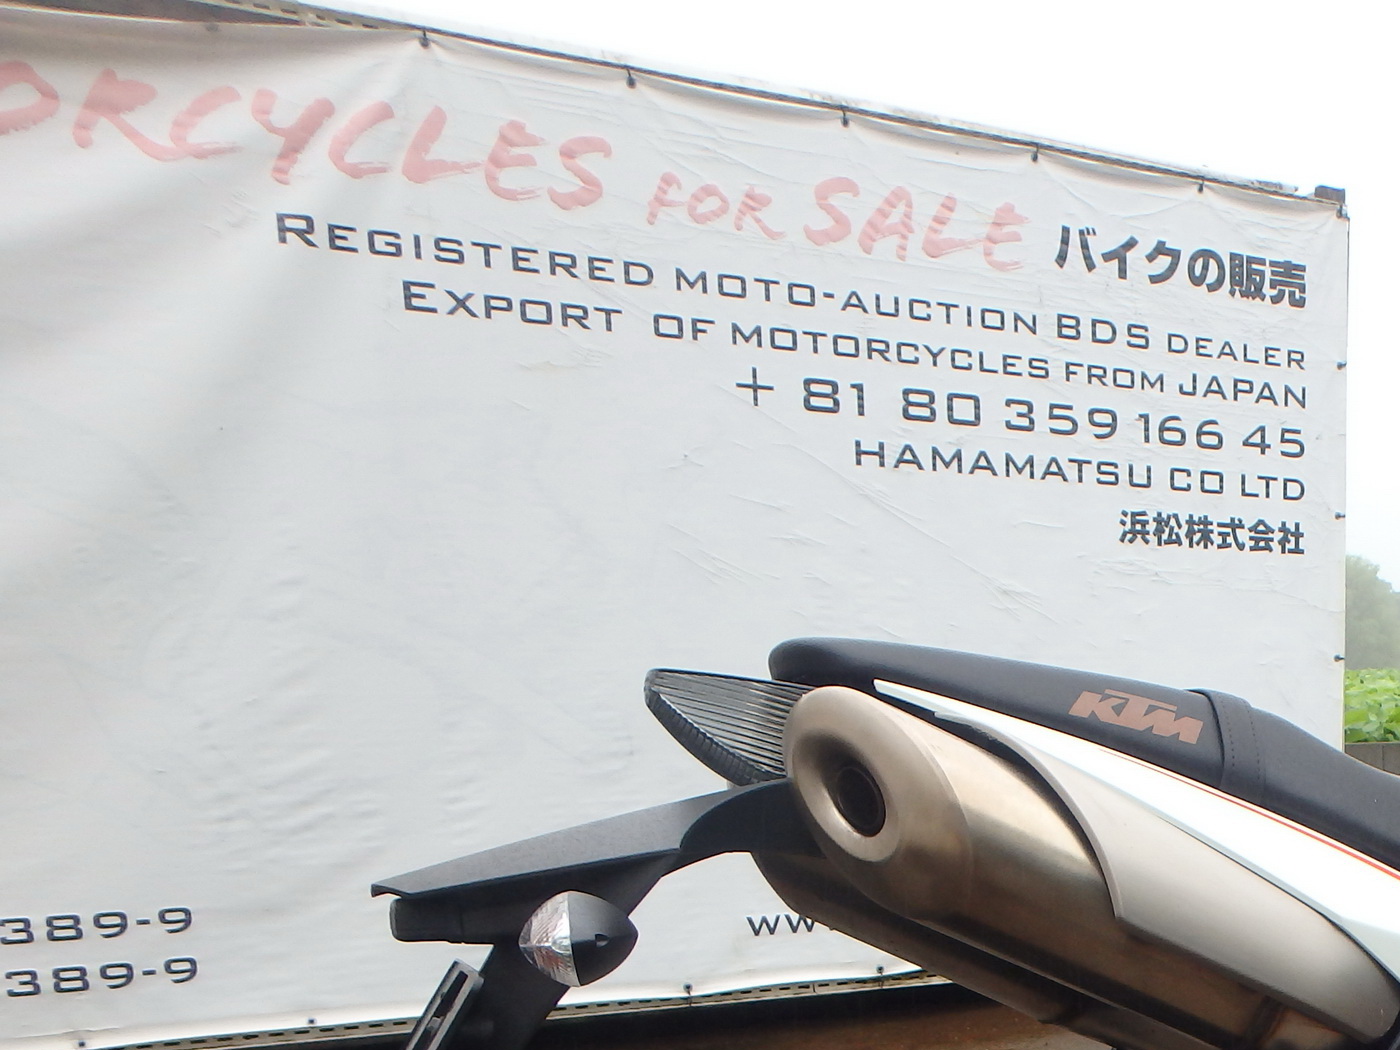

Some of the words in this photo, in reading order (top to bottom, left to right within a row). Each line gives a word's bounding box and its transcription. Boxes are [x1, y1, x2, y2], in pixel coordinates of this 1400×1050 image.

[646, 170, 782, 239] FOR
[803, 175, 1030, 272] SALE
[276, 212, 654, 288] REGISTERED
[675, 267, 1037, 337] MOTO-AUCTION
[1056, 313, 1150, 350] BDS
[1167, 332, 1306, 371] DEALER
[1054, 224, 1307, 309] バイクの販売
[402, 279, 623, 333] EXPORT
[652, 313, 716, 342] OF
[731, 322, 1050, 380] MOTORCYCLES
[1064, 361, 1165, 393] FROM
[1178, 372, 1307, 410] JAPAN
[735, 366, 775, 407] +
[802, 377, 866, 417] 81
[901, 387, 982, 427] 80
[1004, 398, 1118, 440] 359
[1134, 412, 1224, 451] 166
[1241, 425, 1306, 459] 45
[854, 439, 1152, 489] HAMAMATSU
[1169, 467, 1225, 495] CO
[1240, 473, 1306, 502] LTD
[1118, 510, 1305, 555] 浜松株式会社
[1068, 688, 1204, 745] KTM
[0, 906, 193, 945] 389-9
[5, 956, 198, 998] 389-9
